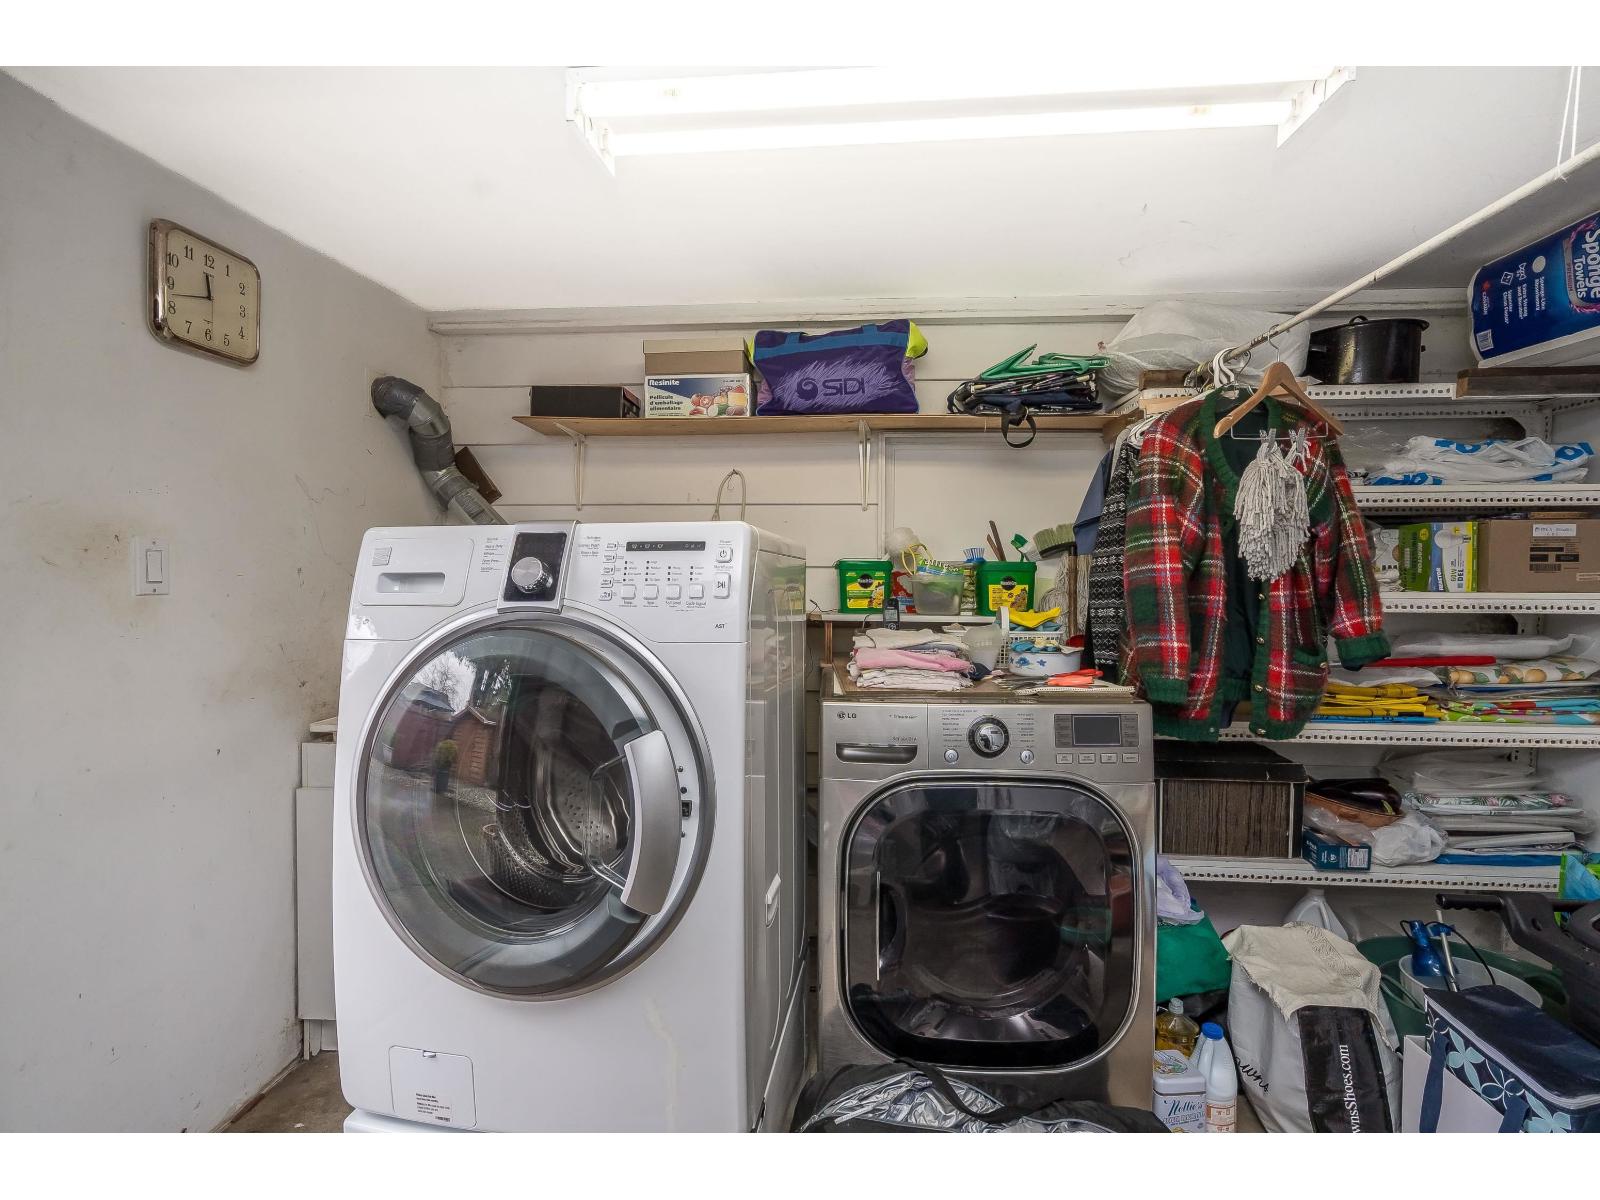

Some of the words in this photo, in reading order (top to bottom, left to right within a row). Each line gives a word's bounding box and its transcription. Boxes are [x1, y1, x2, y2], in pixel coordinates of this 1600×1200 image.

[184, 245, 193, 260] 11
[167, 252, 179, 268] 10
[204, 254, 215, 269] 12
[1582, 230, 1600, 298] Sponge
[226, 264, 230, 277] 1
[1574, 255, 1588, 298] Towels
[167, 276, 174, 290] 9
[239, 282, 245, 296] 2
[168, 301, 176, 314] 8
[240, 305, 246, 318] 3
[185, 320, 192, 334] 7
[239, 326, 245, 339] 4
[205, 329, 212, 341] 6
[223, 334, 230, 346] 5
[822, 377, 865, 396] SIDI
[1164, 1100, 1204, 1116] Nellie's
